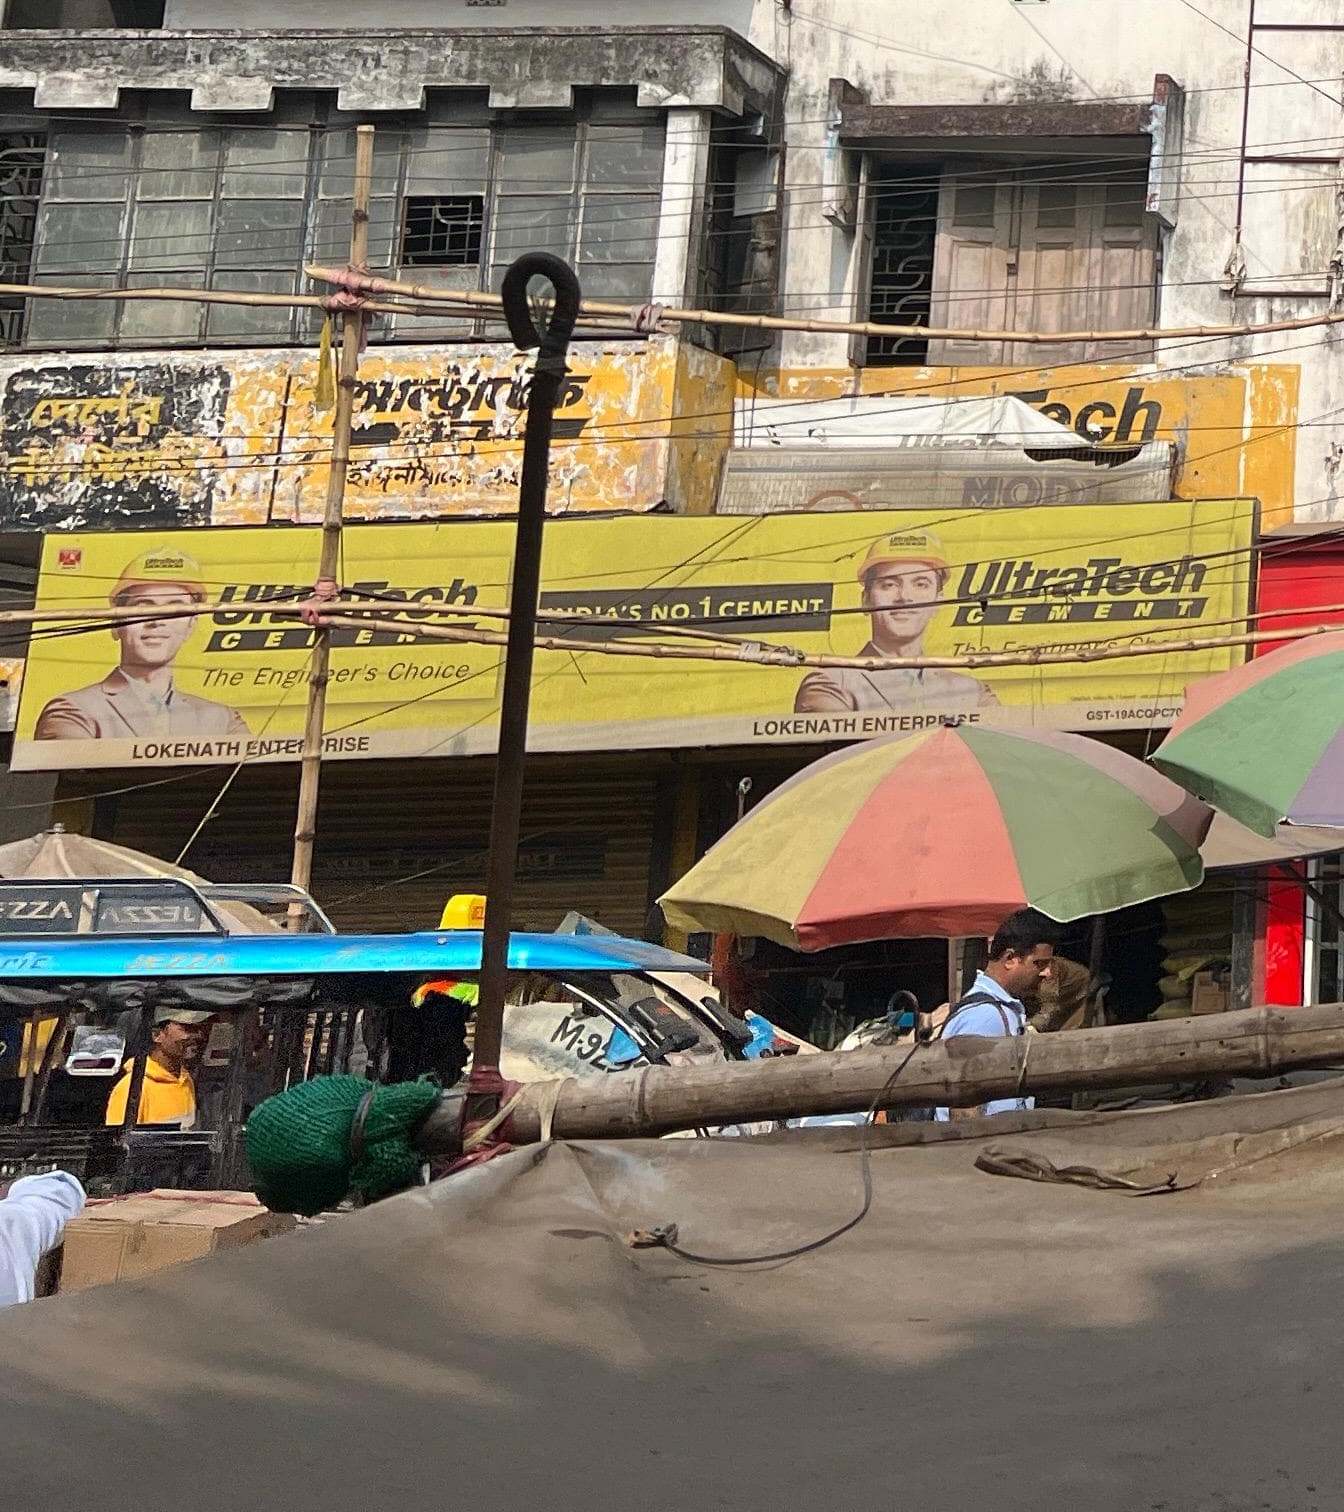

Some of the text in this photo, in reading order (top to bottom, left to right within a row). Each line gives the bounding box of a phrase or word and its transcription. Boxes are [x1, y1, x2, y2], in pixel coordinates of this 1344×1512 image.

[956, 555, 1207, 600] UltraTech
[719, 598, 825, 618] CEMENT
[966, 601, 1195, 624] CEMENT
[202, 661, 470, 689] The Engieer's Choice
[753, 718, 857, 736] LOKENATH
[132, 741, 241, 760] LOKENATH
[0, 901, 73, 919] ZZA
